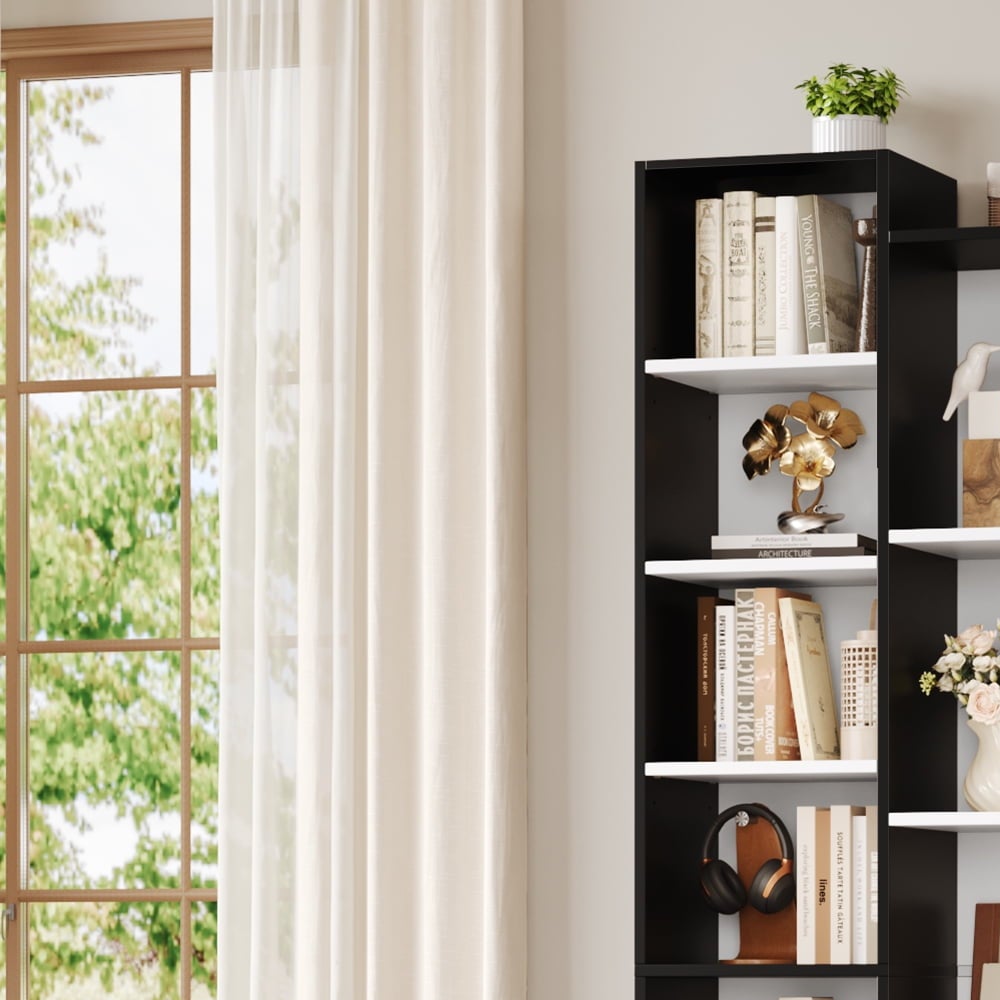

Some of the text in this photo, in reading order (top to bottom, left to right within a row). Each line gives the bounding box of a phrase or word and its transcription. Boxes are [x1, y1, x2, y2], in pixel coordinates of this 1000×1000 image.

[801, 213, 821, 330] YOUNG THE SHACK
[758, 550, 812, 558] ARCHITECTURE
[755, 601, 765, 656] CHAPMAN
[768, 612, 776, 646] CALLUM
[737, 598, 754, 756] БОРИС ПАСТЕРНАК
